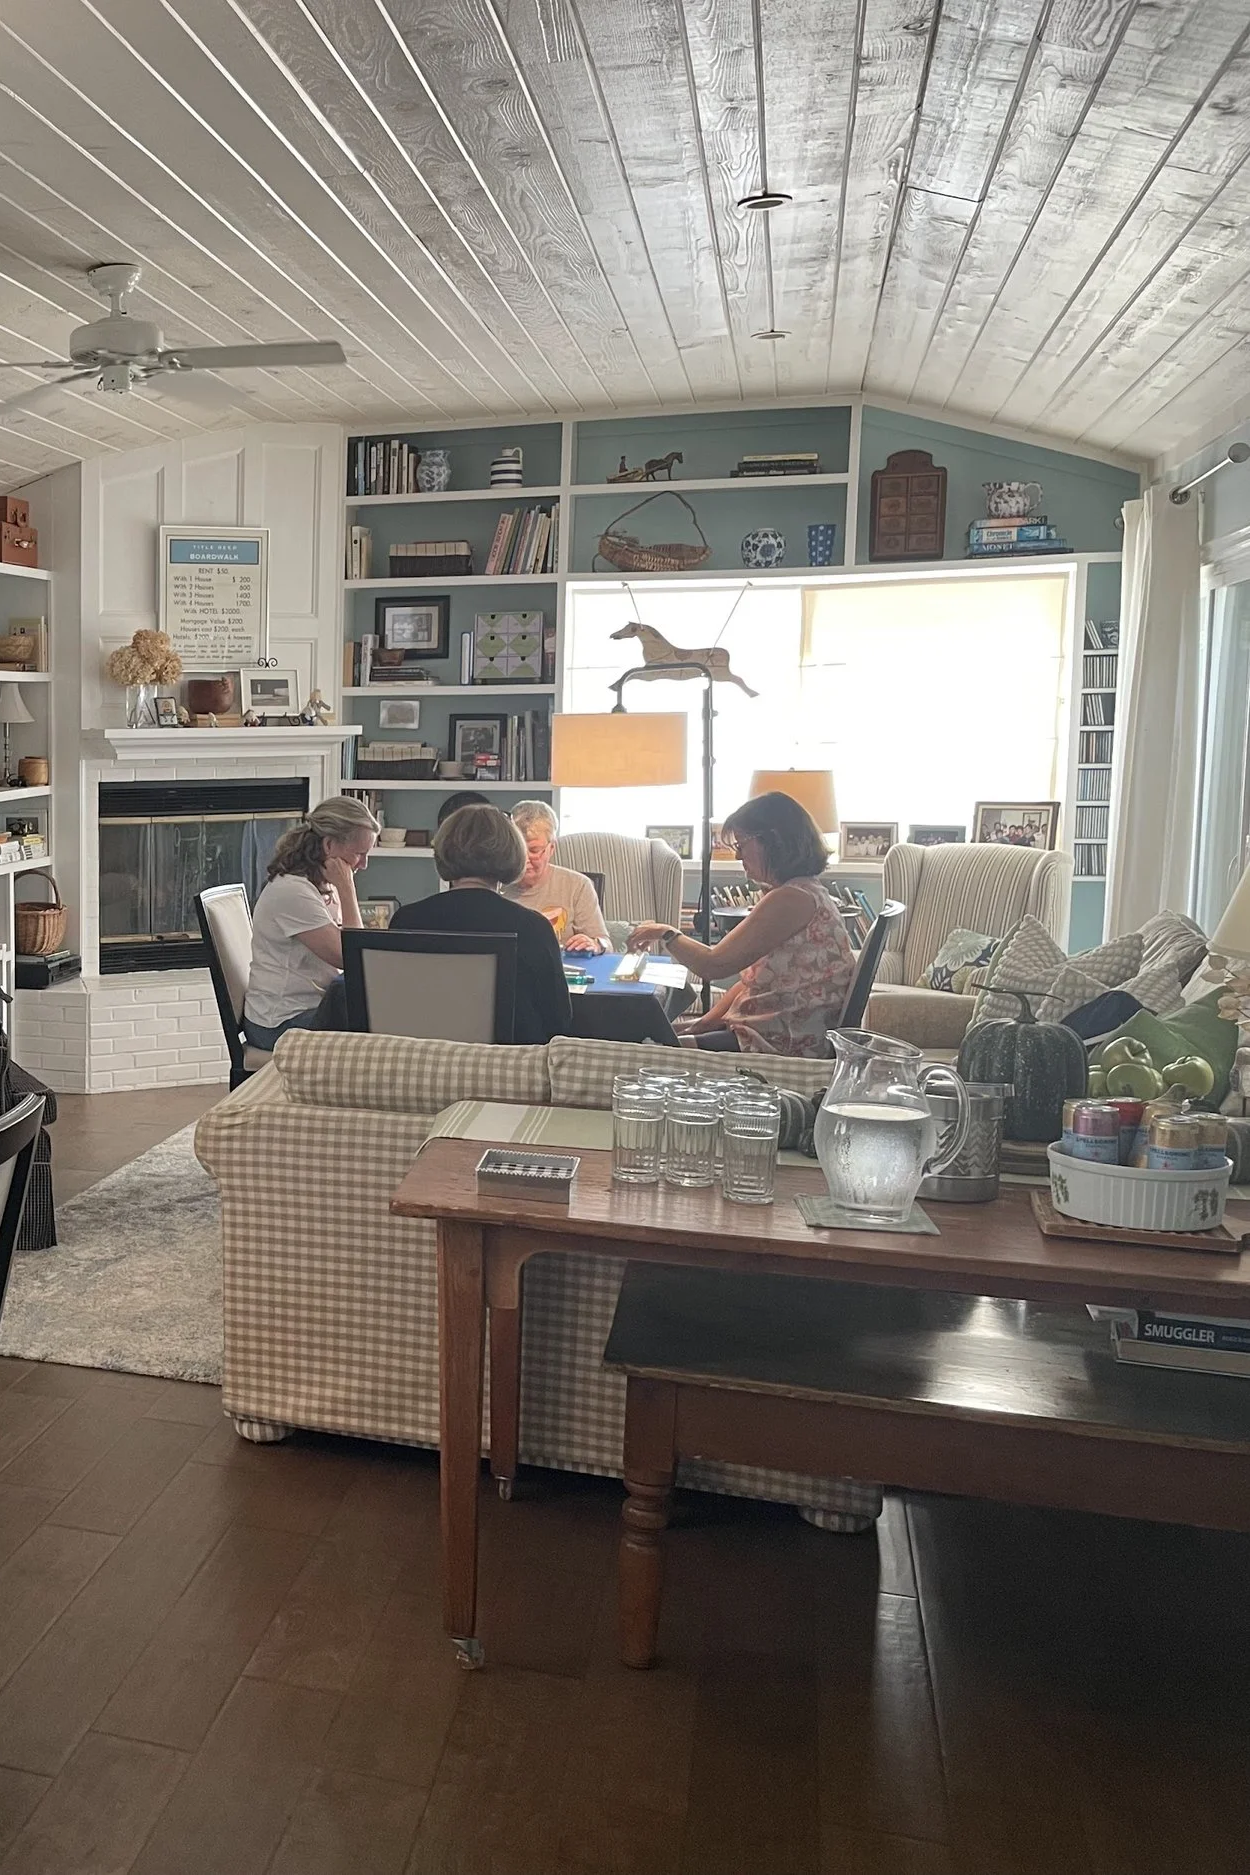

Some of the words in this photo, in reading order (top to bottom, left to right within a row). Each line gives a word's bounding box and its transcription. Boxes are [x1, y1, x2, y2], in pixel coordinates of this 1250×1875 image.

[982, 543, 1013, 552] MONET
[189, 553, 239, 561] BOARDWALK
[1144, 1323, 1215, 1343] SMUGGLER
